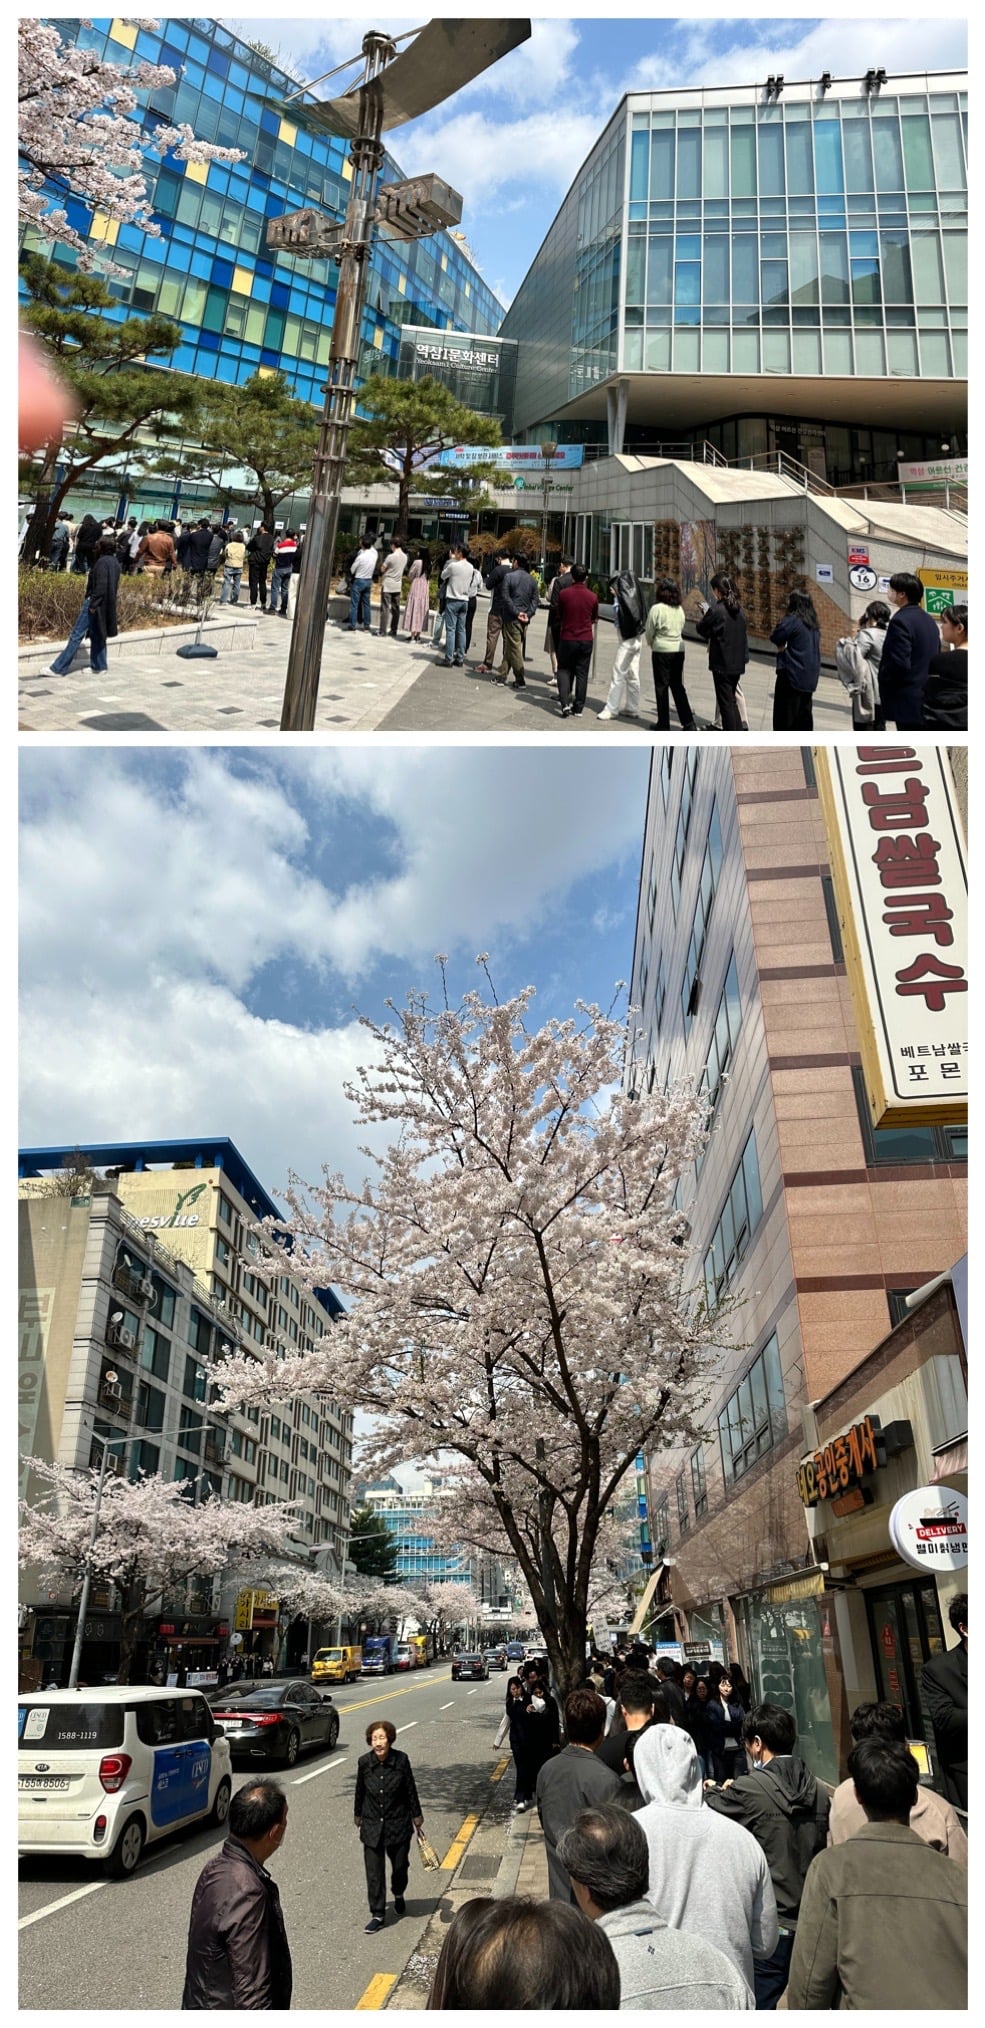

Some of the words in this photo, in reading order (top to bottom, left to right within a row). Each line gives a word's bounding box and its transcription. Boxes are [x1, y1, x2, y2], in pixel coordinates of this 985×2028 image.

[556, 483, 574, 492] Center
[857, 574, 870, 584] 16
[919, 1525, 963, 1537] DELIVERY
[58, 1731, 97, 1740] 1588-1119
